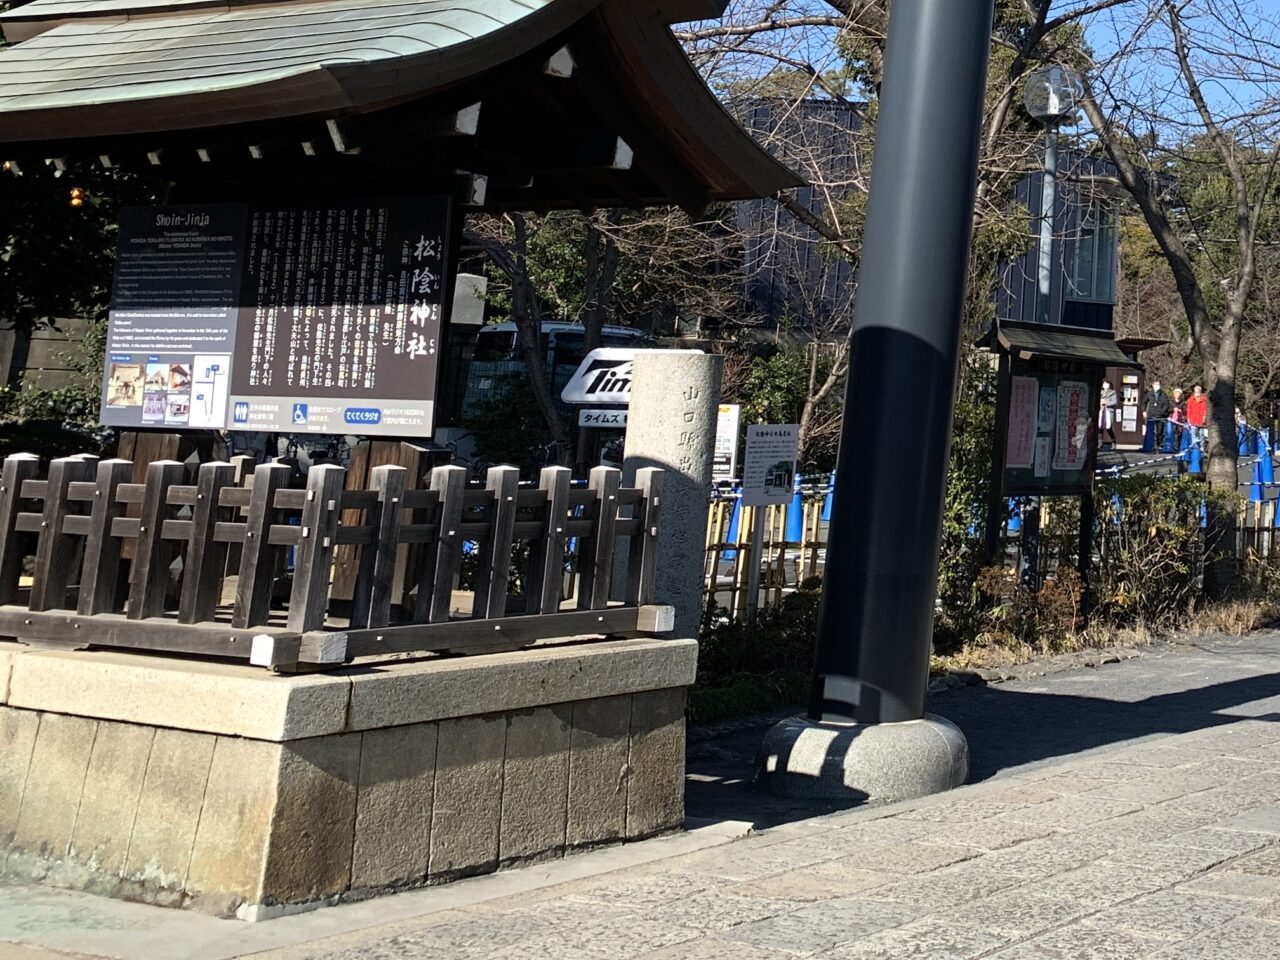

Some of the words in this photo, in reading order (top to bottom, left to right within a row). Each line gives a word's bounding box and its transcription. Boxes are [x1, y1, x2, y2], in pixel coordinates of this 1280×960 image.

[406, 234, 435, 360] 松陰神社
[346, 411, 379, 421] てくてくラジオ
[584, 414, 620, 424] タイムズ
